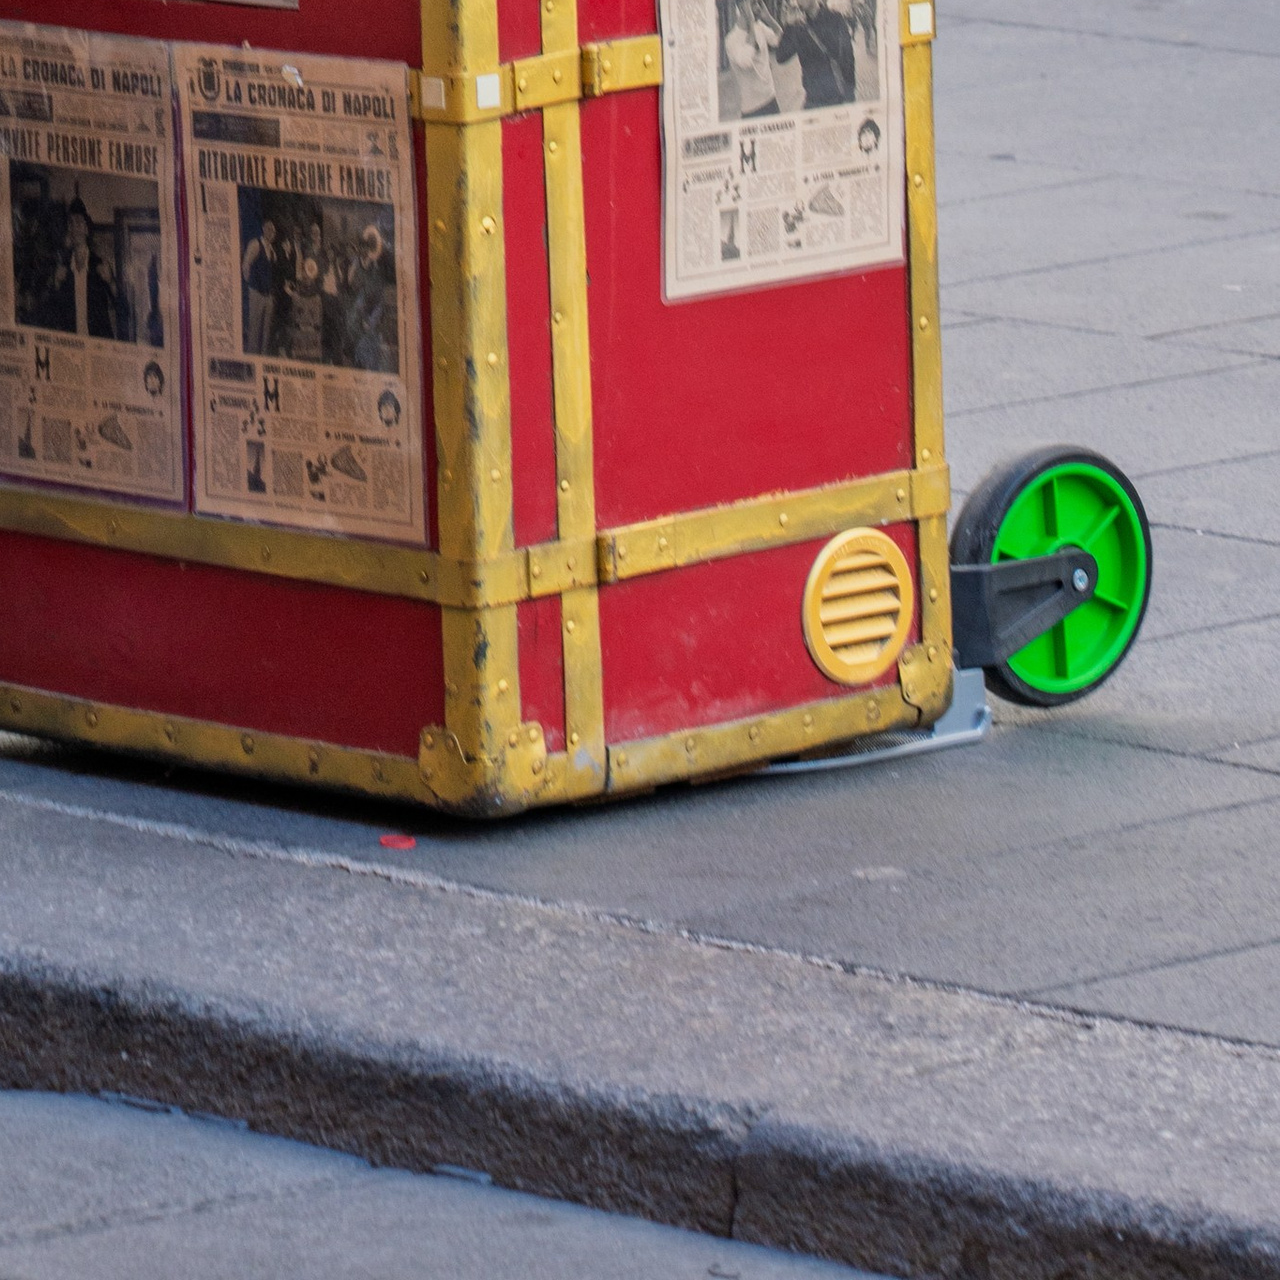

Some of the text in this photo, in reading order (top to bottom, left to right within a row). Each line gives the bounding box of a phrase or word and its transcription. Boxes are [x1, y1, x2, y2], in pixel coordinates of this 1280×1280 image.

[0, 56, 162, 98] LA CRONACA DI NAPOLI
[225, 79, 395, 120] LA CRONACA DI NAPOLI
[47, 132, 103, 168] PERSONE
[109, 140, 158, 175] FAMOSE
[740, 139, 757, 174] M
[199, 149, 392, 201] RITROVATE PERSONE FAMOSE
[35, 345, 51, 381] M
[263, 375, 280, 412] M
